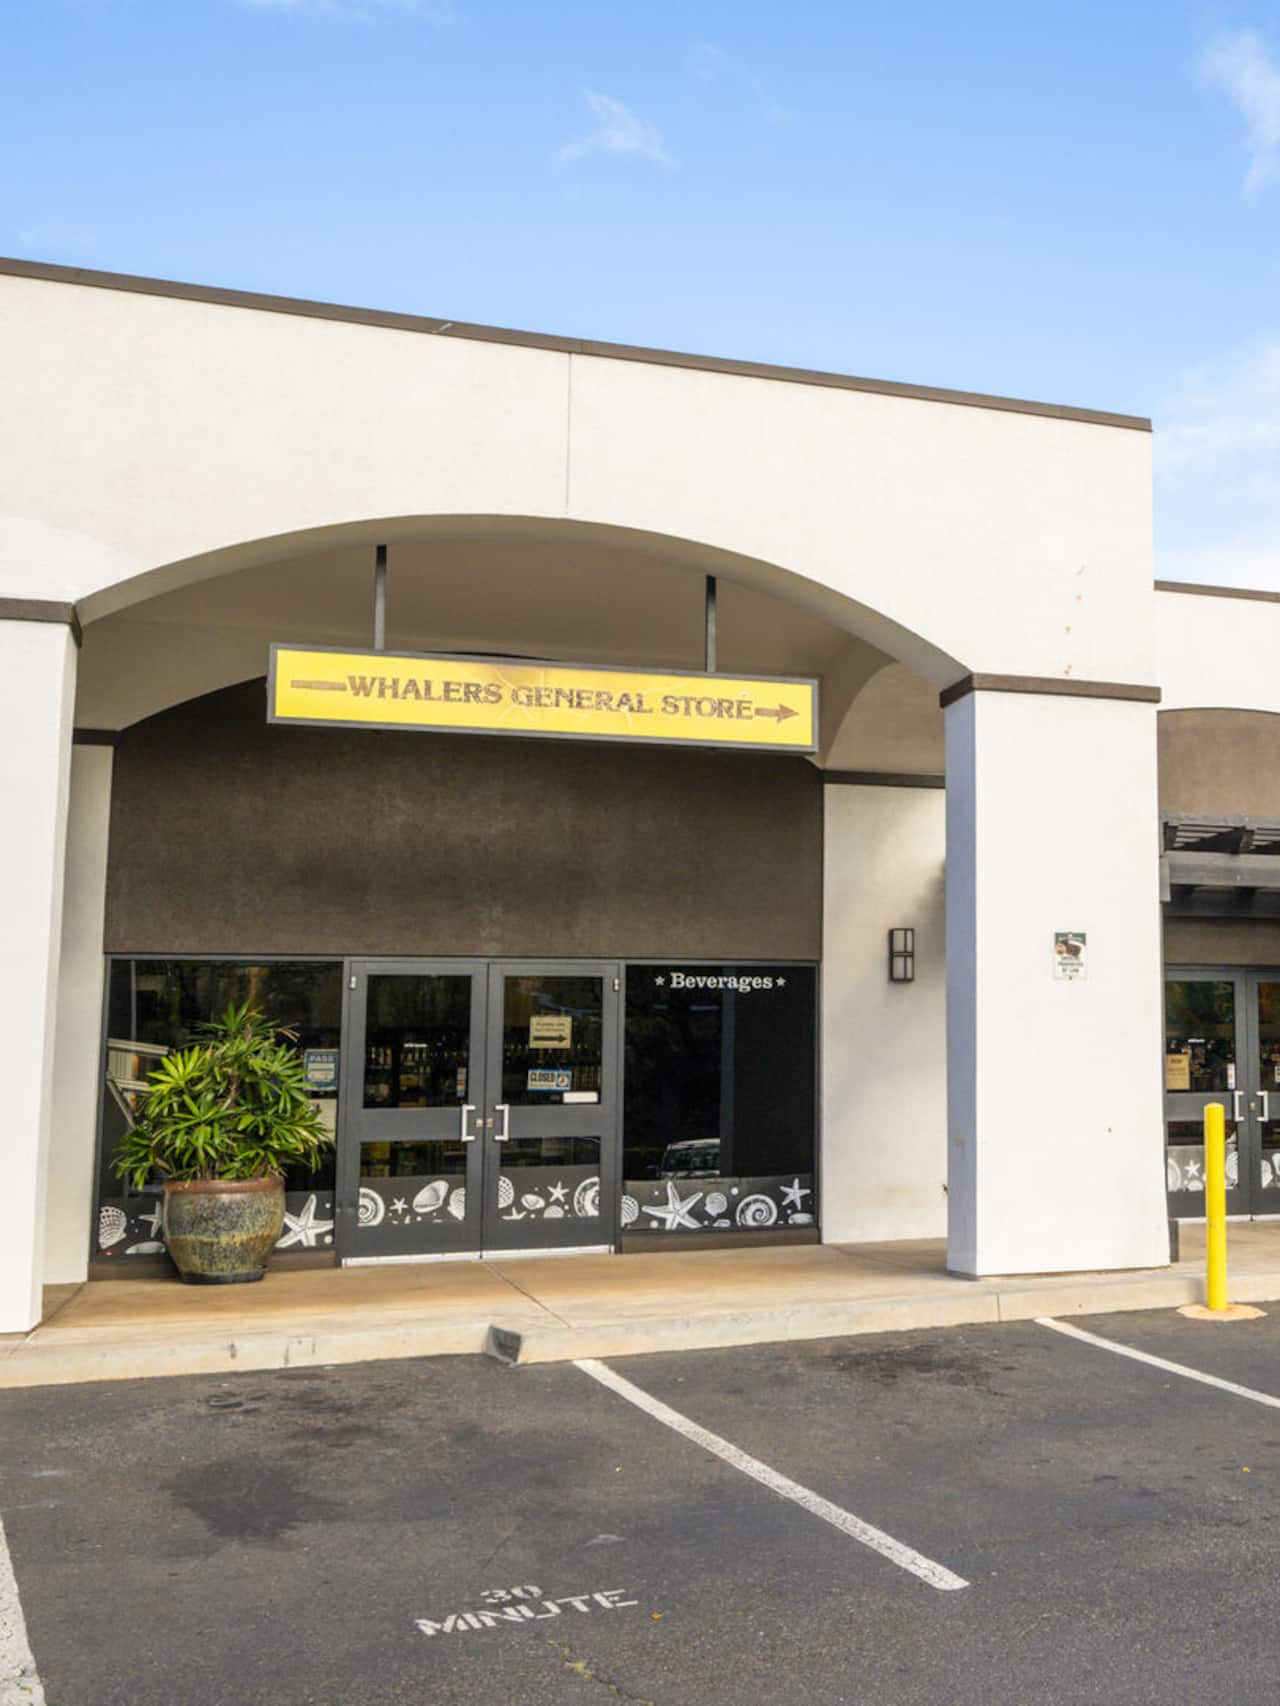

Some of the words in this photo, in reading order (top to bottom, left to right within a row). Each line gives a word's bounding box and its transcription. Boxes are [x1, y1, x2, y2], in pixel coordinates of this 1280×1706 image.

[346, 674, 503, 705] WHALERS
[511, 685, 653, 713] GENERAL
[661, 694, 754, 720] STORE
[669, 971, 774, 993] Beverages
[530, 1072, 555, 1083] CLOSED
[479, 1584, 543, 1604] 30
[414, 1588, 639, 1636] MINUTE
